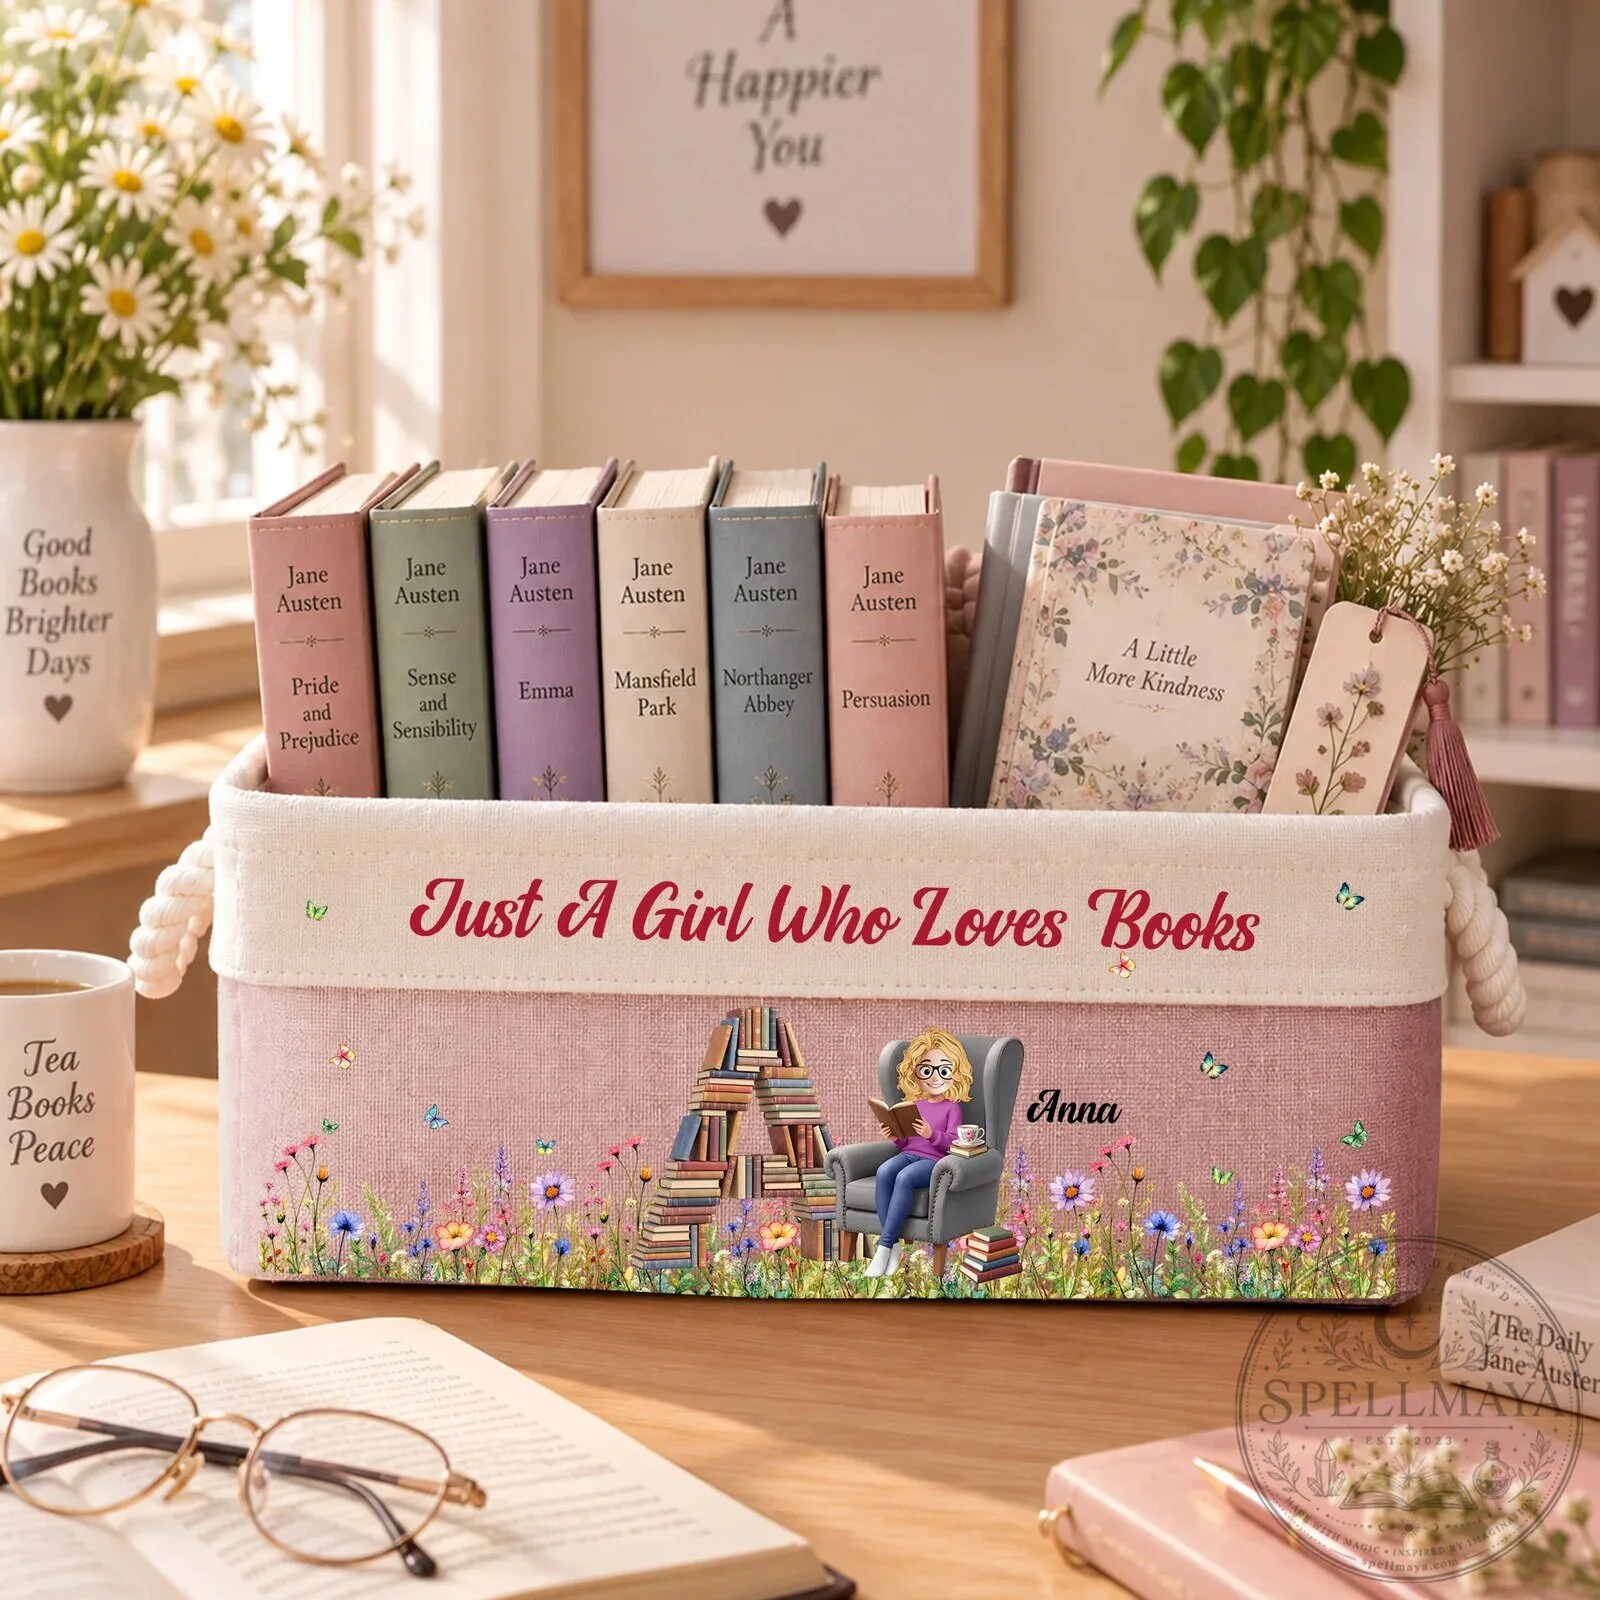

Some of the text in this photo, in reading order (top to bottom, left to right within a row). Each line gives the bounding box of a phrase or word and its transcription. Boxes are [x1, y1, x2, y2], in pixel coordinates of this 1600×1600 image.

[757, 0, 797, 43] A
[685, 49, 882, 117] Happier
[747, 117, 825, 175] You
[23, 527, 92, 563] Good
[287, 566, 328, 588] Jane
[406, 557, 446, 581] Jane
[520, 557, 560, 579] Jane
[632, 557, 673, 580] Jane
[745, 556, 786, 579] Jane
[863, 566, 904, 589] Jane
[18, 565, 98, 597] Books
[276, 594, 342, 614] Austen
[395, 585, 460, 605] Austen
[510, 584, 573, 603] Austen
[620, 586, 686, 604] Austen
[733, 584, 798, 603] Austen
[851, 593, 917, 612] Austen
[5, 605, 113, 643] Brighter
[1121, 638, 1198, 668] A Little
[27, 647, 92, 683] Days
[292, 675, 339, 695] Pride
[407, 668, 457, 687] Sense
[615, 668, 696, 689] Mansfield
[723, 668, 813, 689] Northanger
[1085, 661, 1226, 702] More Kindness
[519, 681, 574, 700] Emma
[841, 689, 930, 710] Persuasion
[303, 704, 332, 721] and
[419, 694, 447, 712] and
[638, 696, 677, 717] Park
[743, 695, 795, 717] Abbey
[280, 729, 359, 753] Prejudice
[393, 719, 477, 741] Sensibility
[409, 877, 1261, 953] Just A Girl Who Loves Books
[23, 1038, 80, 1077] Tea
[7, 1081, 95, 1121] Books
[1027, 1089, 1122, 1124] Anna
[9, 1129, 95, 1166] Peace
[1490, 1310, 1594, 1364] The Daily
[1479, 1343, 1527, 1376] Jane
